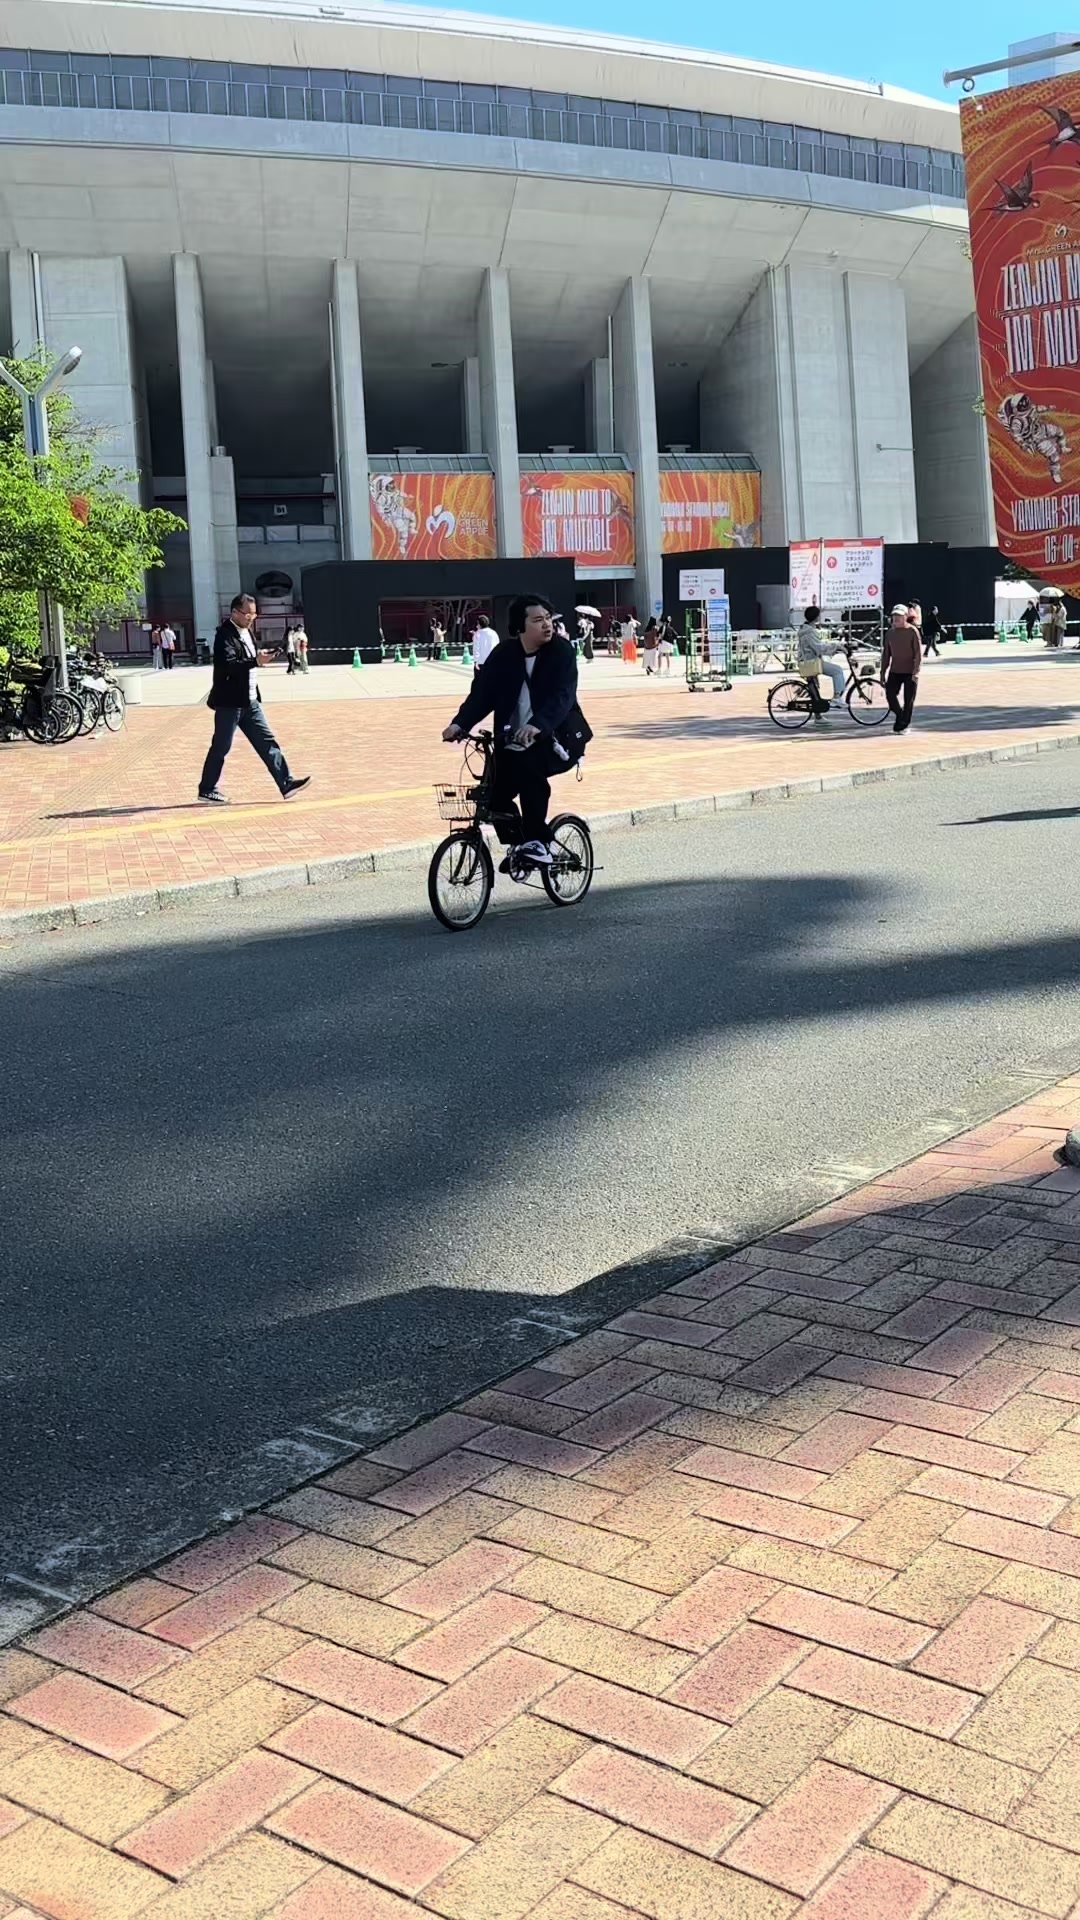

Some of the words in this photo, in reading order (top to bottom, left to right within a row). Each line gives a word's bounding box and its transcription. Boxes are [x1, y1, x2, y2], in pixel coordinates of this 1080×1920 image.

[1001, 255, 1061, 310] ZENJIN
[541, 488, 574, 516] ZENJIN
[576, 488, 598, 515] MITO
[600, 488, 611, 515] TO
[1010, 496, 1058, 532] YANMAR
[459, 518, 488, 527] GREEN
[459, 527, 488, 536] APPLE
